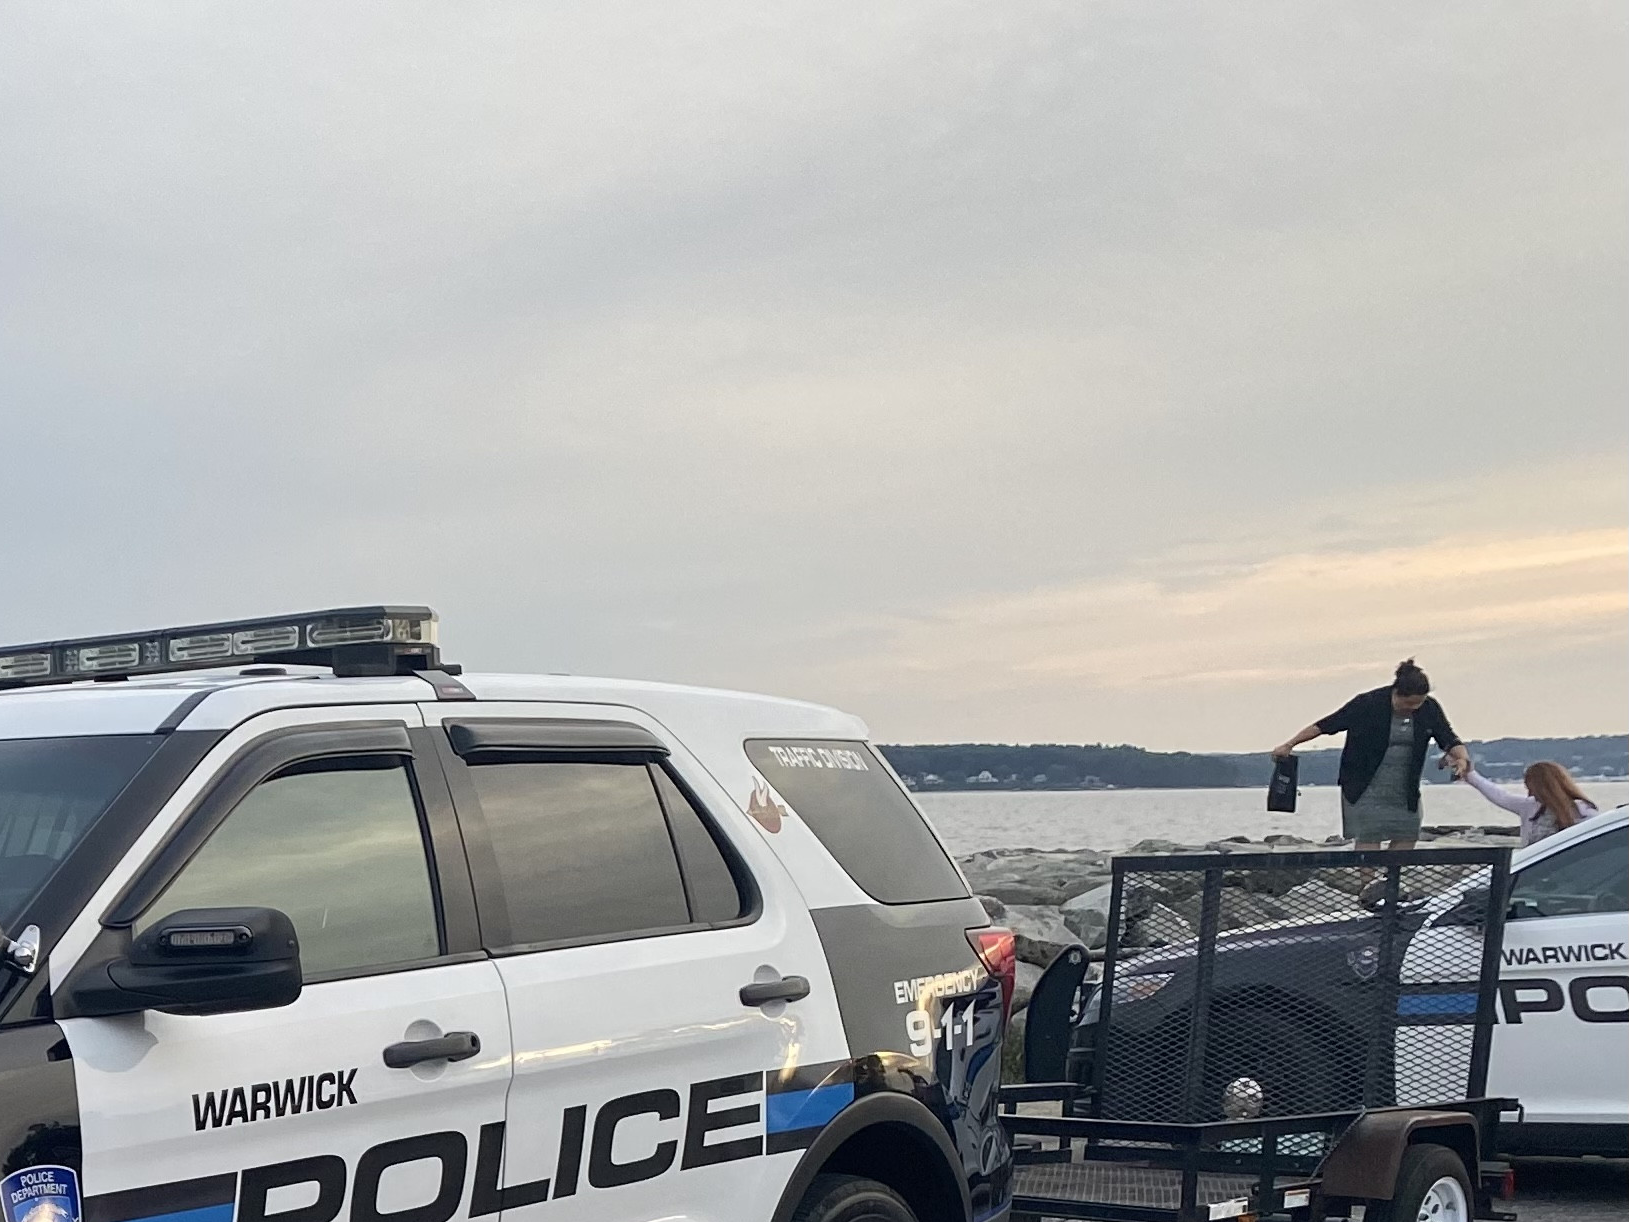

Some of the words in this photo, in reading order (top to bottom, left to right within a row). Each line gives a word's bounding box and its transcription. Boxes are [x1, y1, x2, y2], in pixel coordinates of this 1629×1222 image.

[768, 746, 823, 769] TRAFFIC
[1500, 942, 1628, 966] WARWICK
[894, 969, 978, 1004] EMERGENCY
[906, 999, 976, 1057] 9-1-1
[192, 1068, 358, 1132] WARWICK
[20, 1171, 55, 1187] POLICE
[11, 1183, 68, 1204] DEPARTMENT
